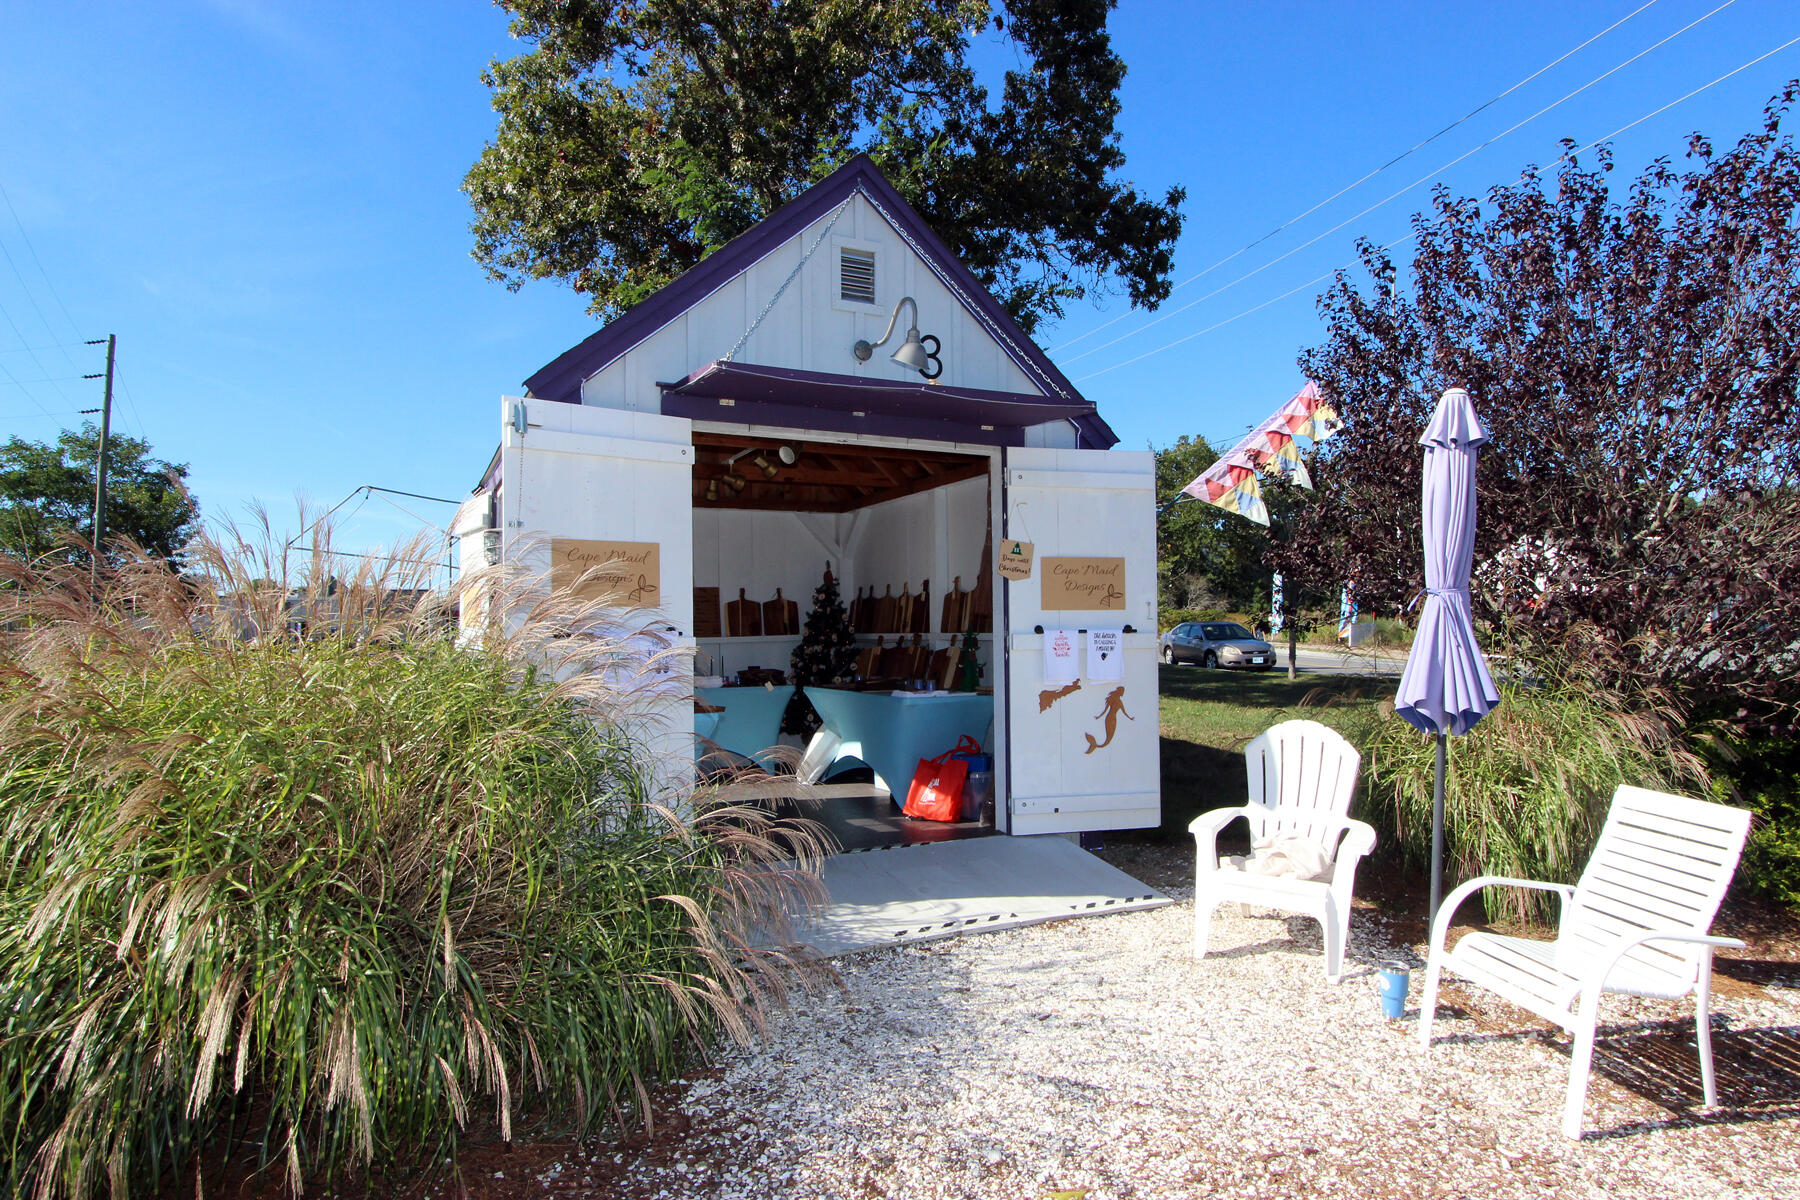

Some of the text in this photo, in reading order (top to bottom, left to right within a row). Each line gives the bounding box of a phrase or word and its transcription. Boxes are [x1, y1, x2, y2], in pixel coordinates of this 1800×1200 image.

[919, 334, 943, 380] 3
[567, 547, 652, 568] Cape Maid
[1053, 563, 1119, 580] Cape Maid
[1064, 580, 1107, 597] Designs
